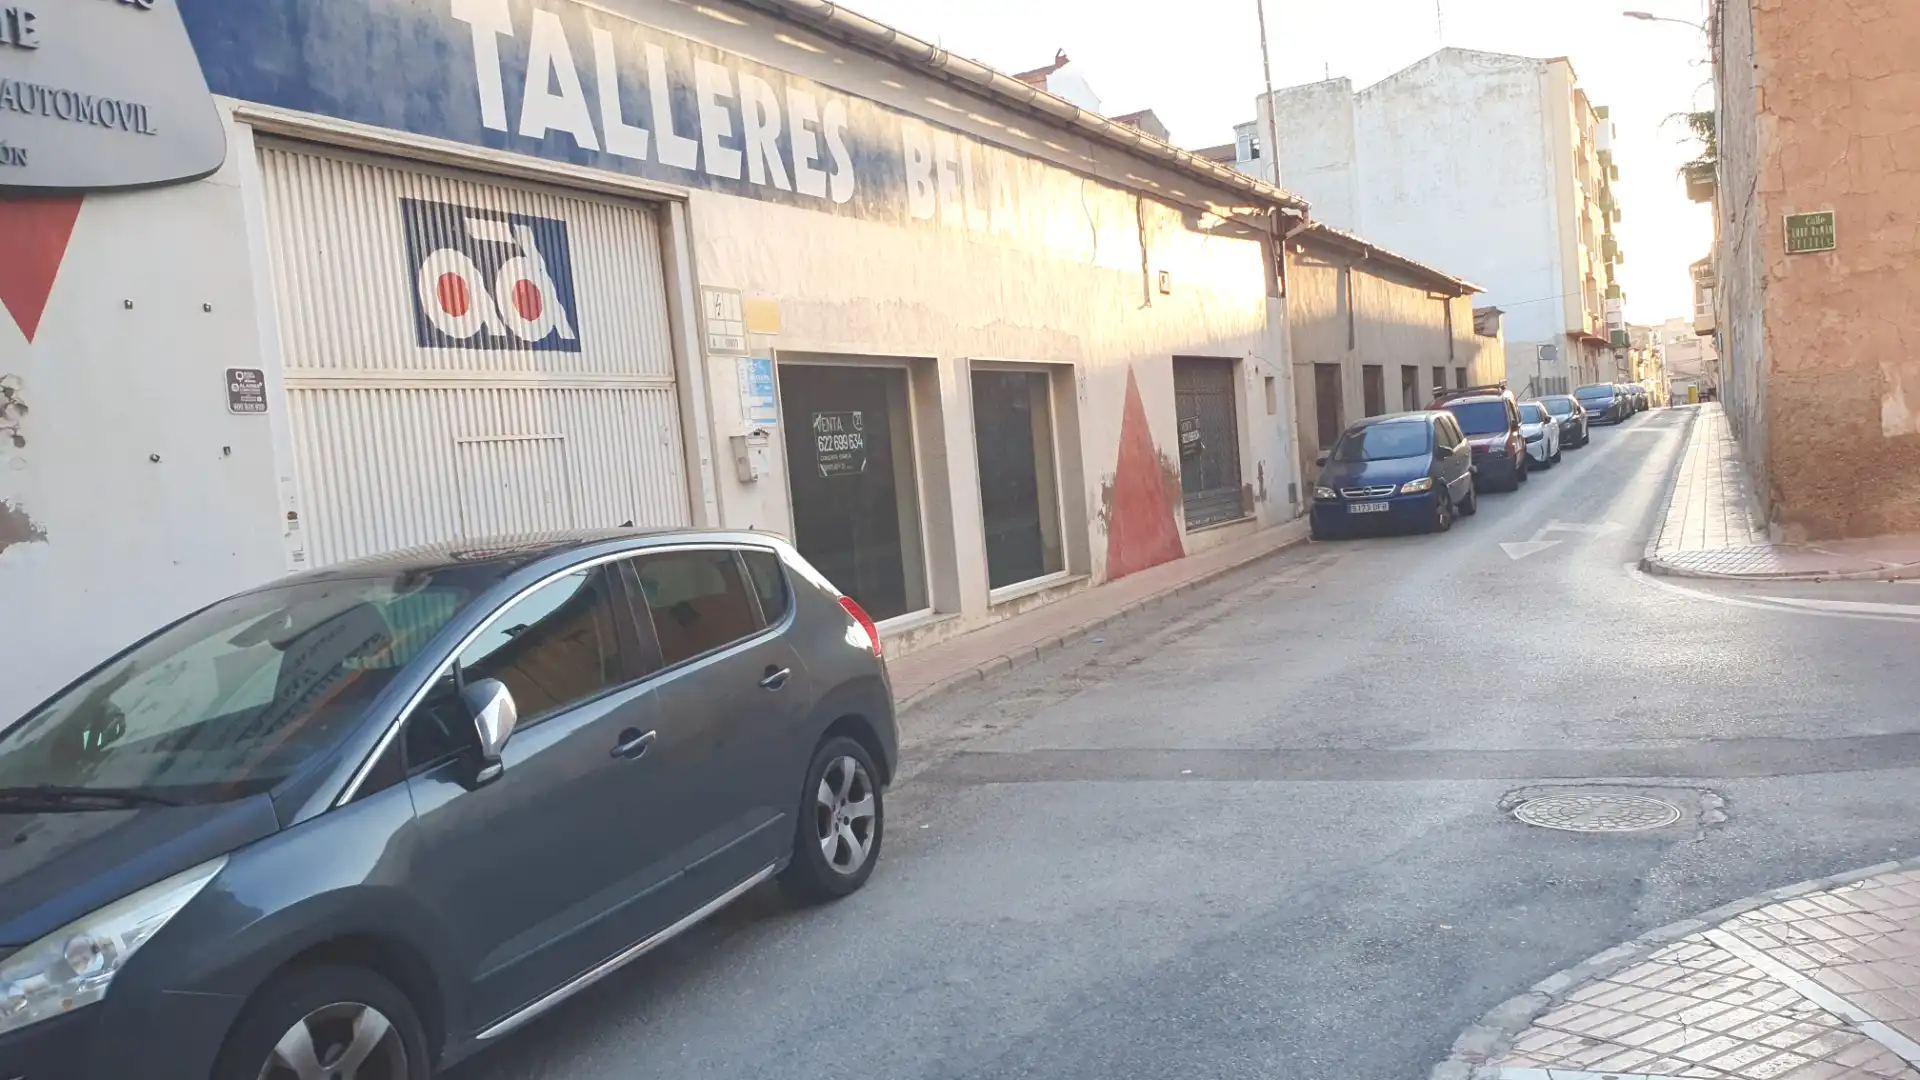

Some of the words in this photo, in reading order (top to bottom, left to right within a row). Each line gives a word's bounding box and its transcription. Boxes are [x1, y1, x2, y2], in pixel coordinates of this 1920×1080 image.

[0, 77, 157, 136] AUTOMOVIL
[451, 0, 855, 204] TALLERES
[1805, 215, 1825, 225] Calle
[815, 416, 843, 432] VENTA
[818, 435, 833, 452] 622
[834, 434, 849, 450] 699
[849, 433, 863, 449] 634
